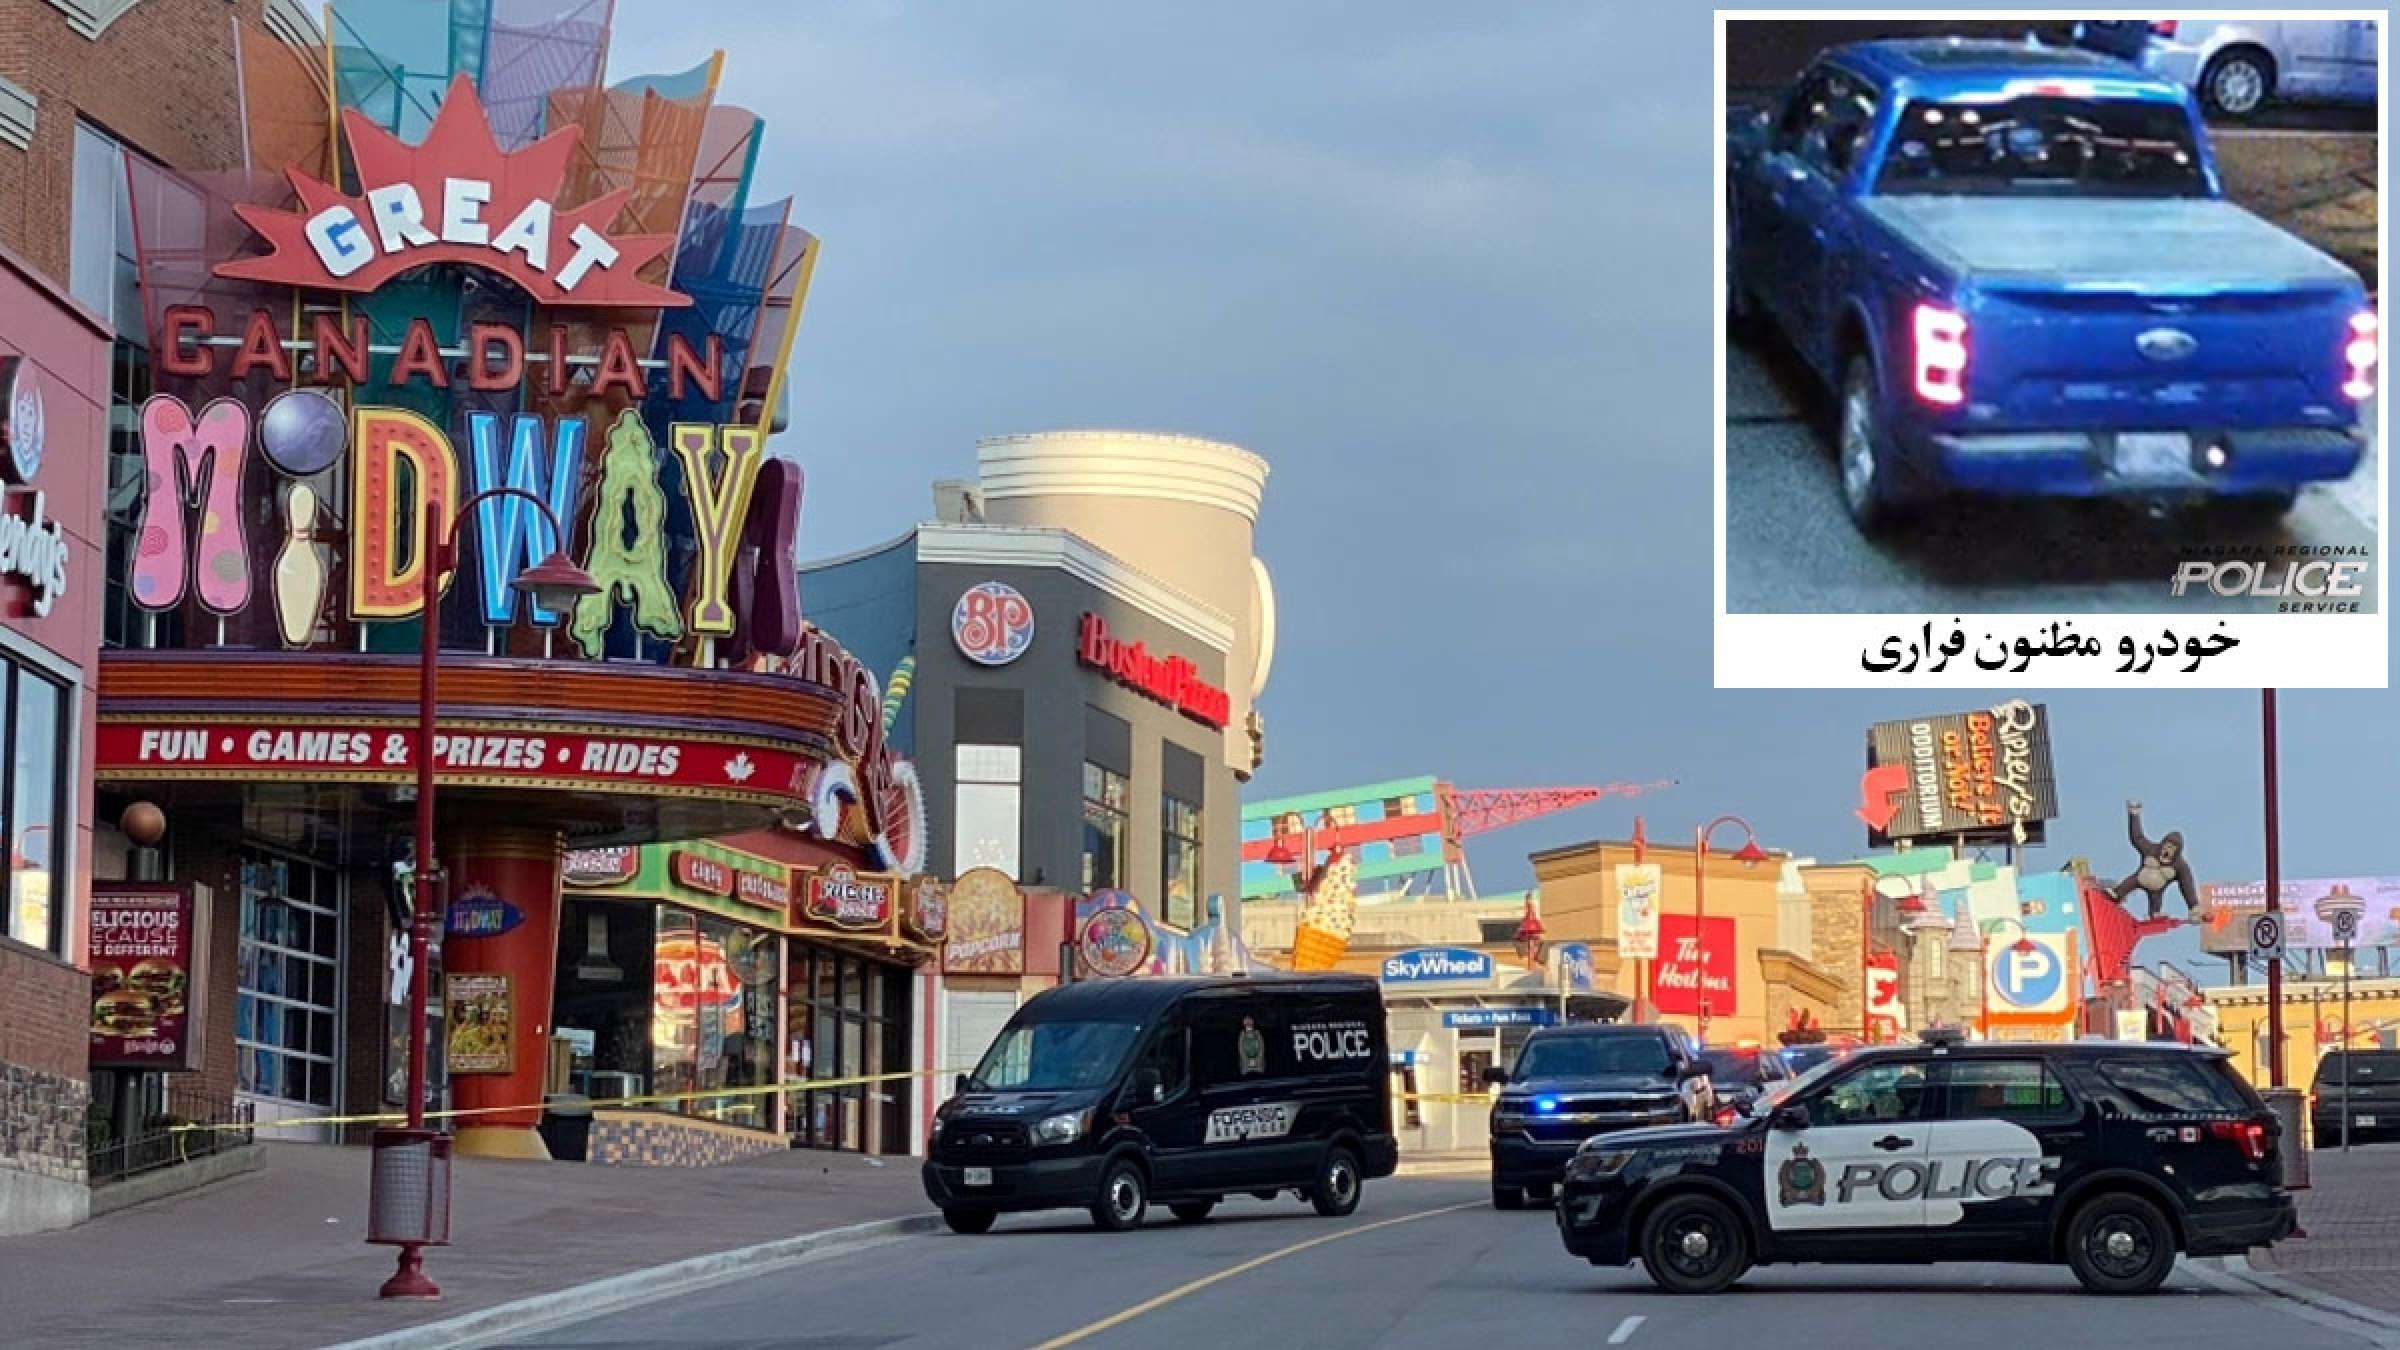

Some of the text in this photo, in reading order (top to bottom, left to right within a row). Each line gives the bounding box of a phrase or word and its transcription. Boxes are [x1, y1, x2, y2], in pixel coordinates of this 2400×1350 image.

[305, 177, 620, 292] GREAT
[160, 304, 724, 401] CANADIAN
[140, 729, 681, 775] FUN GAMES & PRIZES RIDES
[92, 911, 178, 928] ELICIOUS
[92, 928, 177, 943] ECAUSE
[1386, 957, 1484, 978] SkyWheel
[1293, 1029, 1370, 1062] POLICE
[1836, 1156, 2061, 1203] POLICE
